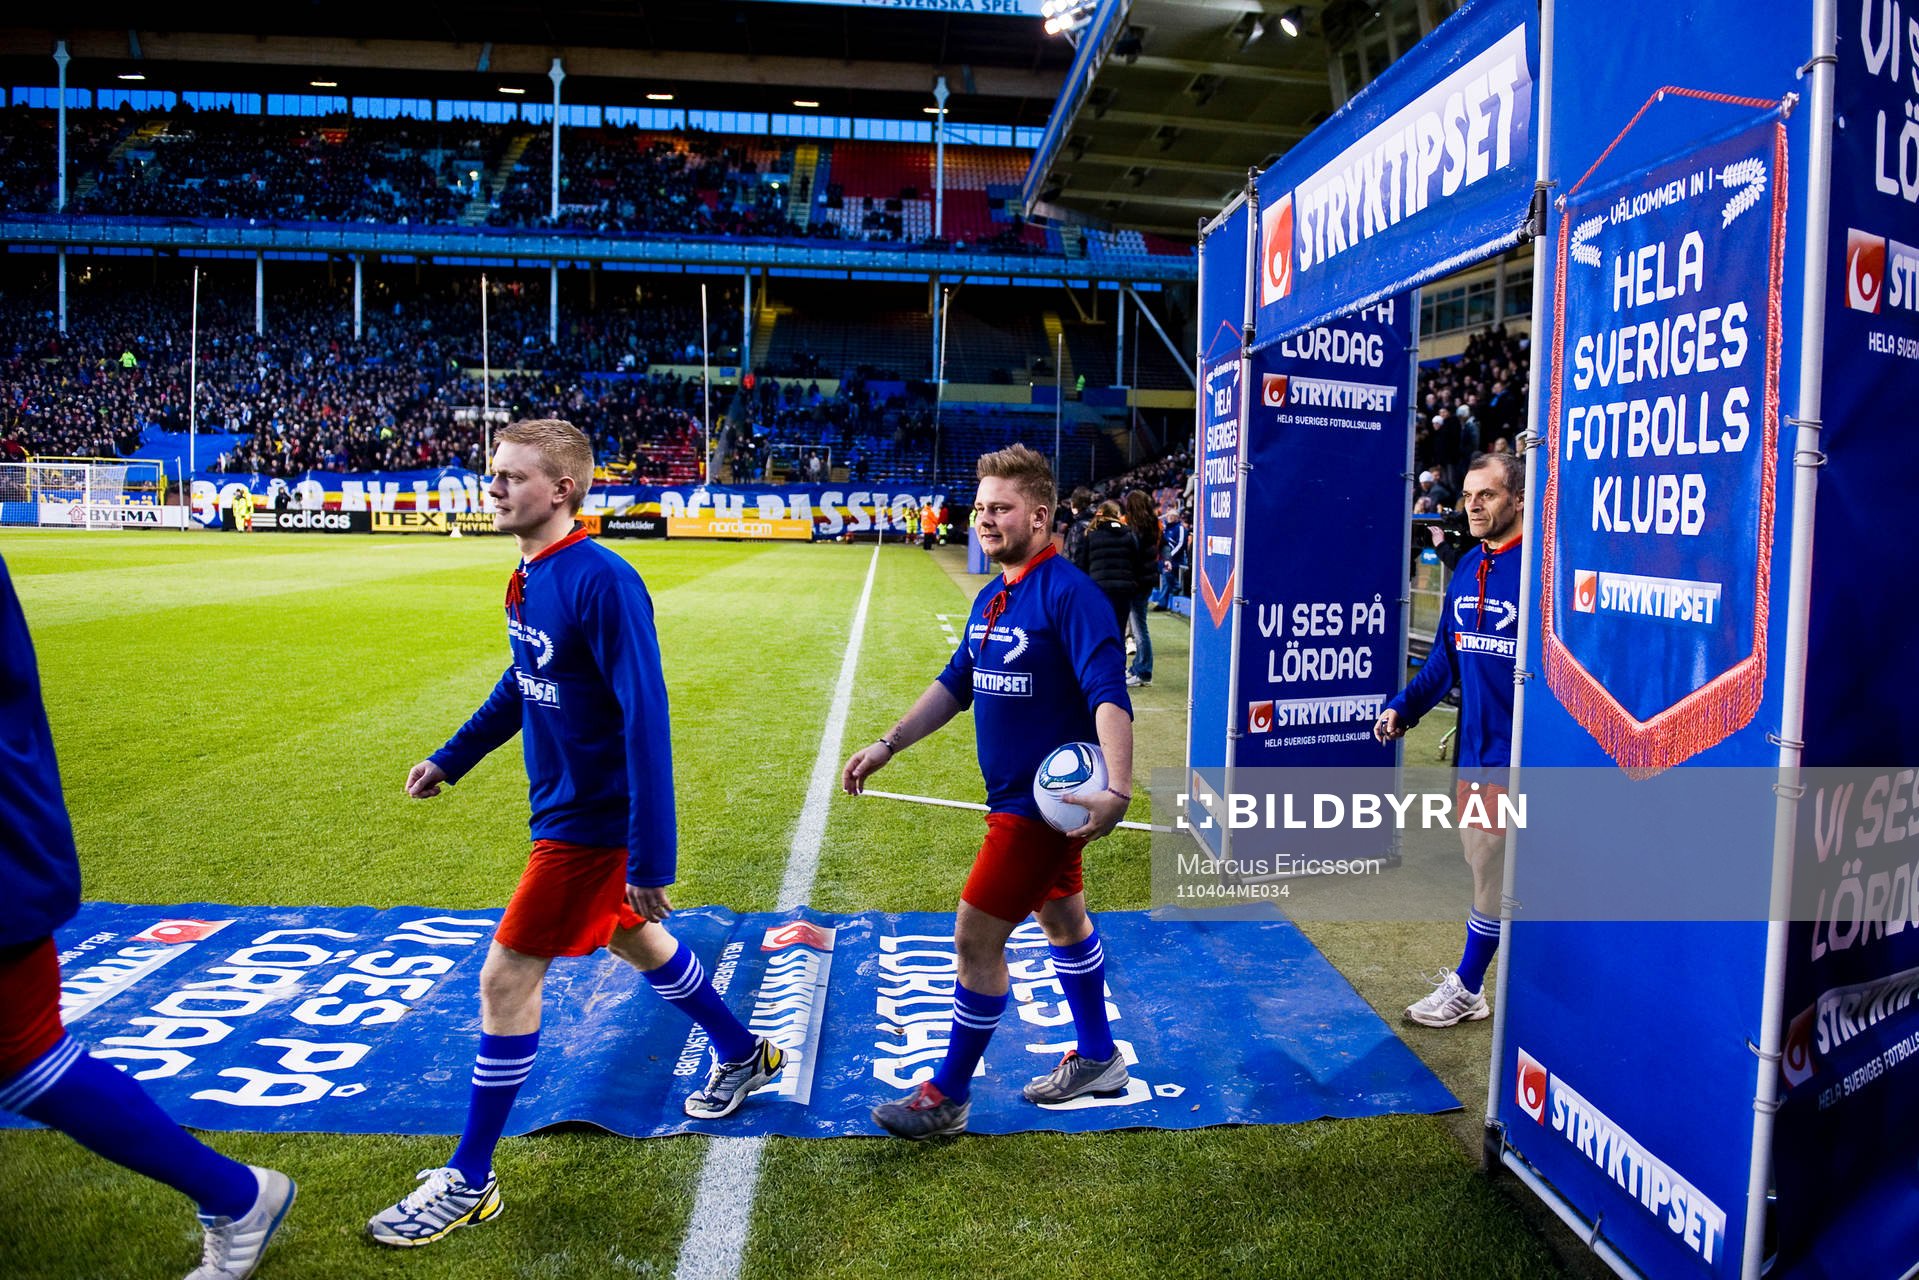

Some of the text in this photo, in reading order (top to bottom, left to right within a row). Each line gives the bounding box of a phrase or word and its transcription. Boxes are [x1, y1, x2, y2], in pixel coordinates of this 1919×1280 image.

[1299, 54, 1519, 272] STRYKTIPSET
[1609, 181, 1687, 225] VÄLKOMMEN
[1690, 173, 1705, 198] IN
[1612, 230, 1705, 312] HELA
[1572, 301, 1749, 391] SVERIGES
[1868, 331, 1895, 355] HELA
[1215, 385, 1232, 418] HELA
[1290, 381, 1395, 413] STRYKTIPSET
[1206, 418, 1238, 453] SVERIGES
[1276, 414, 1382, 431] HELA SVERIGES FOTBOLLSKLUBB
[1566, 386, 1751, 461] FOTBOLLS
[1204, 454, 1237, 486] FOTBOLLS
[278, 511, 351, 530] adidas
[375, 511, 439, 527] ITEX
[608, 518, 655, 530] Arbetskläder
[1210, 490, 1231, 519] KLUBB
[1592, 473, 1707, 536] KLUBB
[1257, 592, 1386, 638] VI SES PÅ
[1599, 579, 1717, 625] STRYKTIPSET
[1267, 640, 1373, 683] LÖRDAG
[1277, 698, 1384, 727] STRYKTIPSET
[1264, 731, 1371, 748] HELA SVERIGES FOTBOLLSKLUBB
[1814, 782, 1855, 863] VI
[73, 931, 119, 952] HELA
[722, 941, 745, 961] HELA
[290, 949, 456, 1026] SES
[189, 1037, 373, 1107] PÅ
[1818, 1083, 1842, 1112] HELA
[1843, 1056, 1884, 1096] SVERIGES
[1551, 1087, 1721, 1265] STRYKTIPSET
